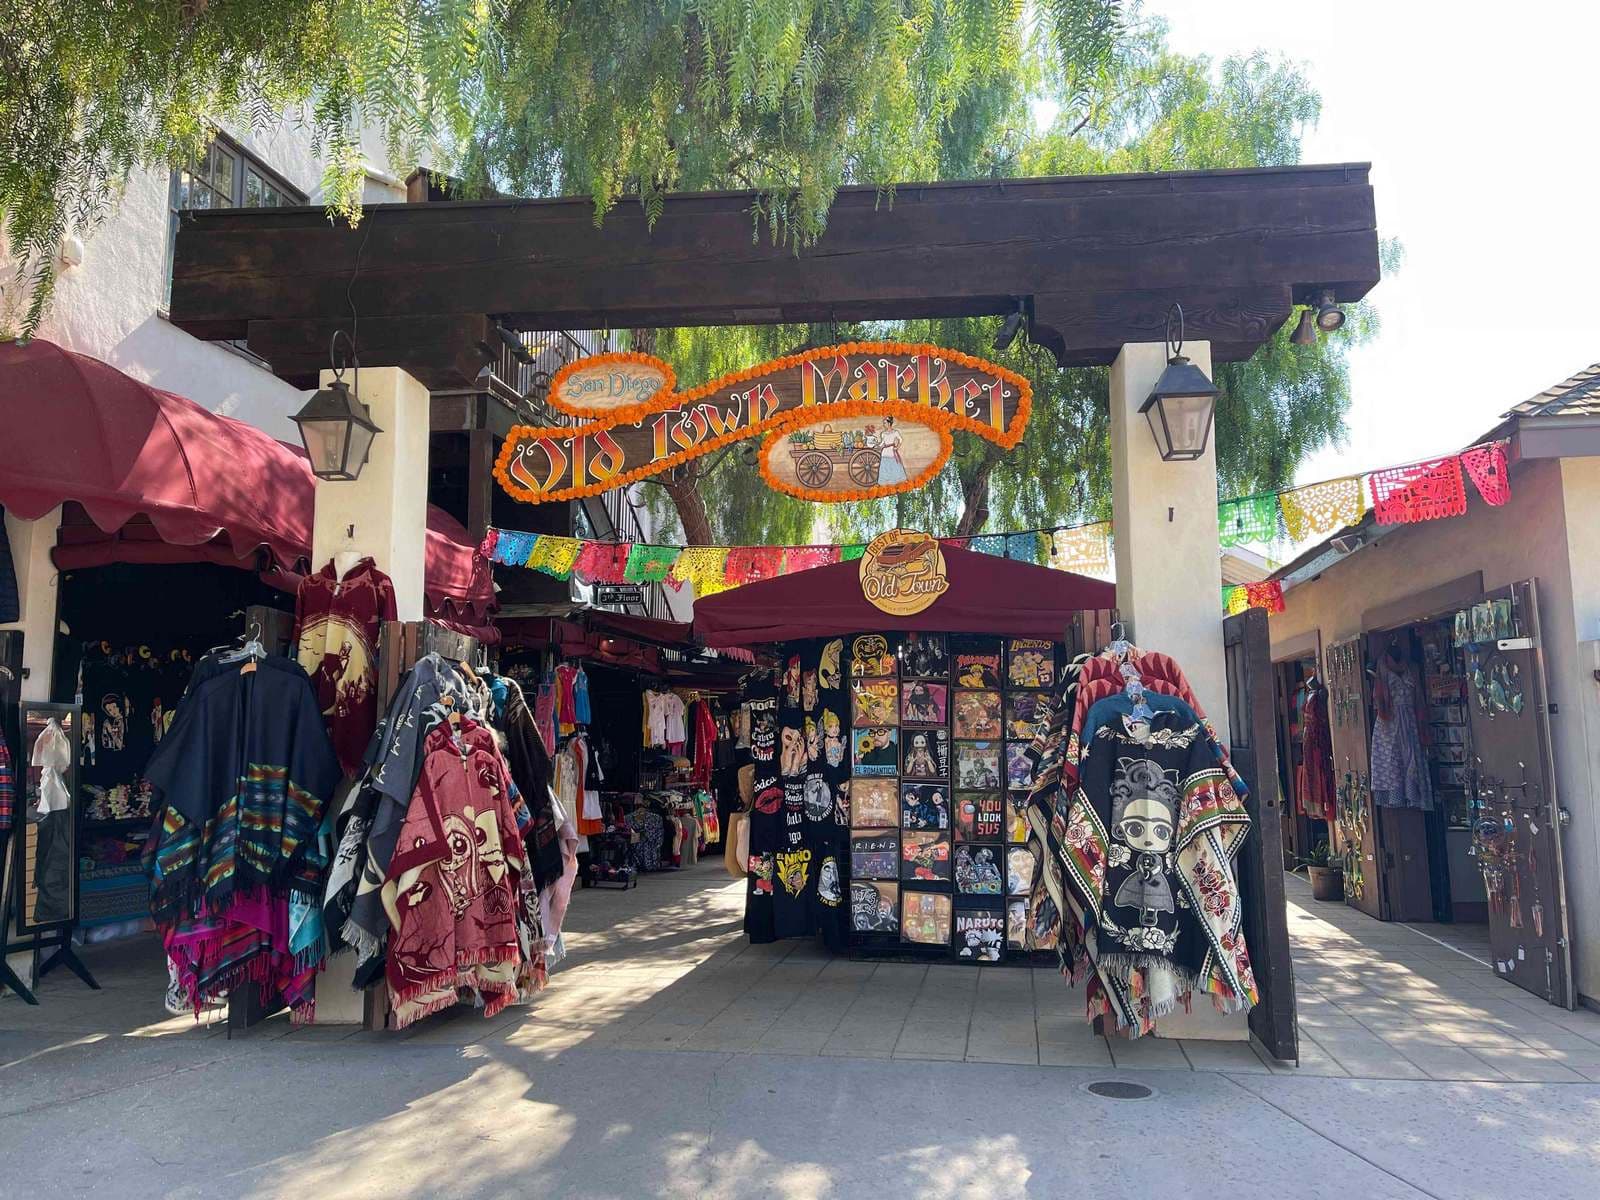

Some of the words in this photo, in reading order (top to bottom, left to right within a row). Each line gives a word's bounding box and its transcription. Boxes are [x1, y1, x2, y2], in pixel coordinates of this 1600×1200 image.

[567, 374, 604, 397] San
[608, 370, 661, 401] Diego
[510, 430, 625, 495] Old
[642, 384, 780, 464] Town
[796, 354, 1010, 433] Market
[870, 537, 889, 555] BEST
[888, 530, 900, 541] OF
[866, 575, 898, 599] Old
[899, 568, 944, 594] Town
[616, 592, 639, 602] Floor
[865, 681, 898, 697] NIÑO
[979, 800, 1001, 812] YOU
[978, 812, 1001, 822] LOOK
[977, 823, 1000, 835] SUS
[785, 849, 812, 865] NIÑO
[957, 916, 1004, 932] NARUTO
